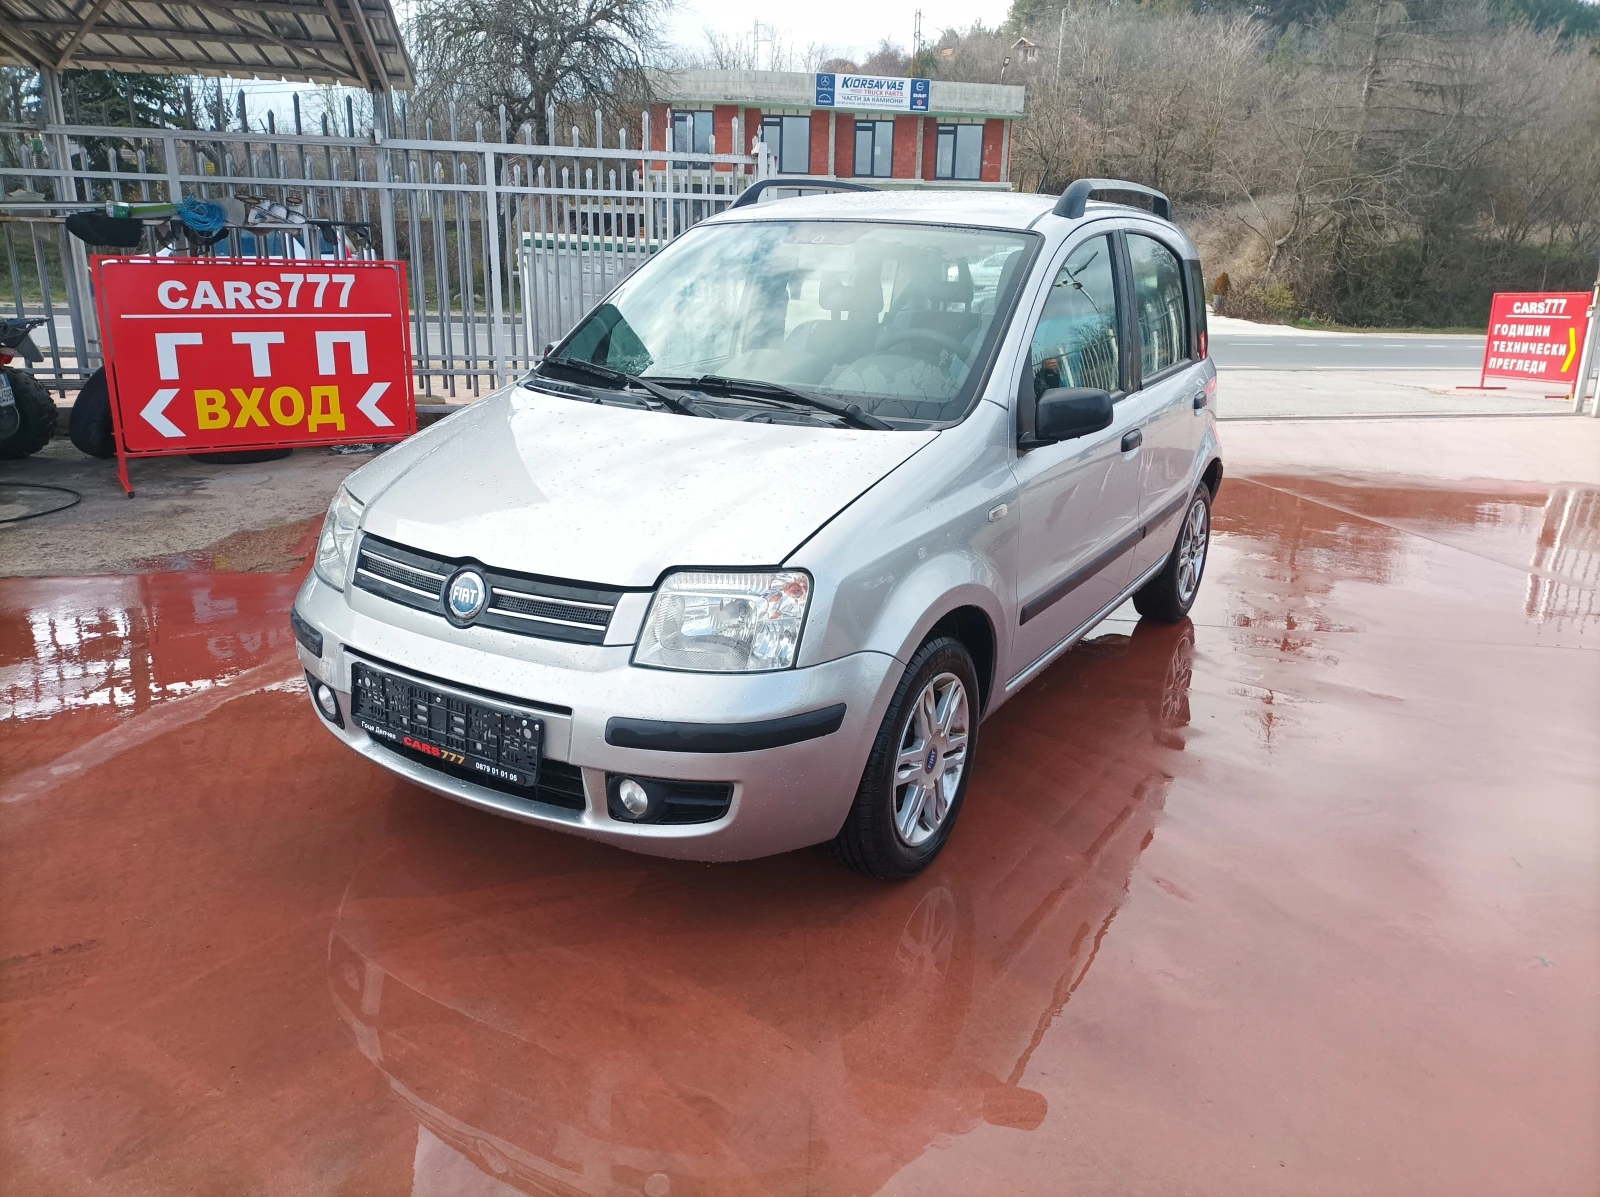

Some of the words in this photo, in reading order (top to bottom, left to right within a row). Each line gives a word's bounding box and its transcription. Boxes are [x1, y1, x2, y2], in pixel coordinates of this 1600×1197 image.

[842, 77, 904, 91] KIORSAVVAS
[157, 273, 355, 310] CARS777
[1513, 299, 1567, 314] CARS777
[1494, 324, 1551, 337] ГОДИШНИ
[1493, 341, 1567, 356] ТЕХНИЧЕСКИ
[1489, 357, 1547, 374] ПРЕГЛЕДИ
[193, 385, 346, 432] ВХОД
[452, 585, 478, 604] FIAT
[403, 735, 465, 765] CARS777
[491, 767, 499, 776] 01
[500, 770, 508, 779] 01
[509, 773, 518, 782] 05
